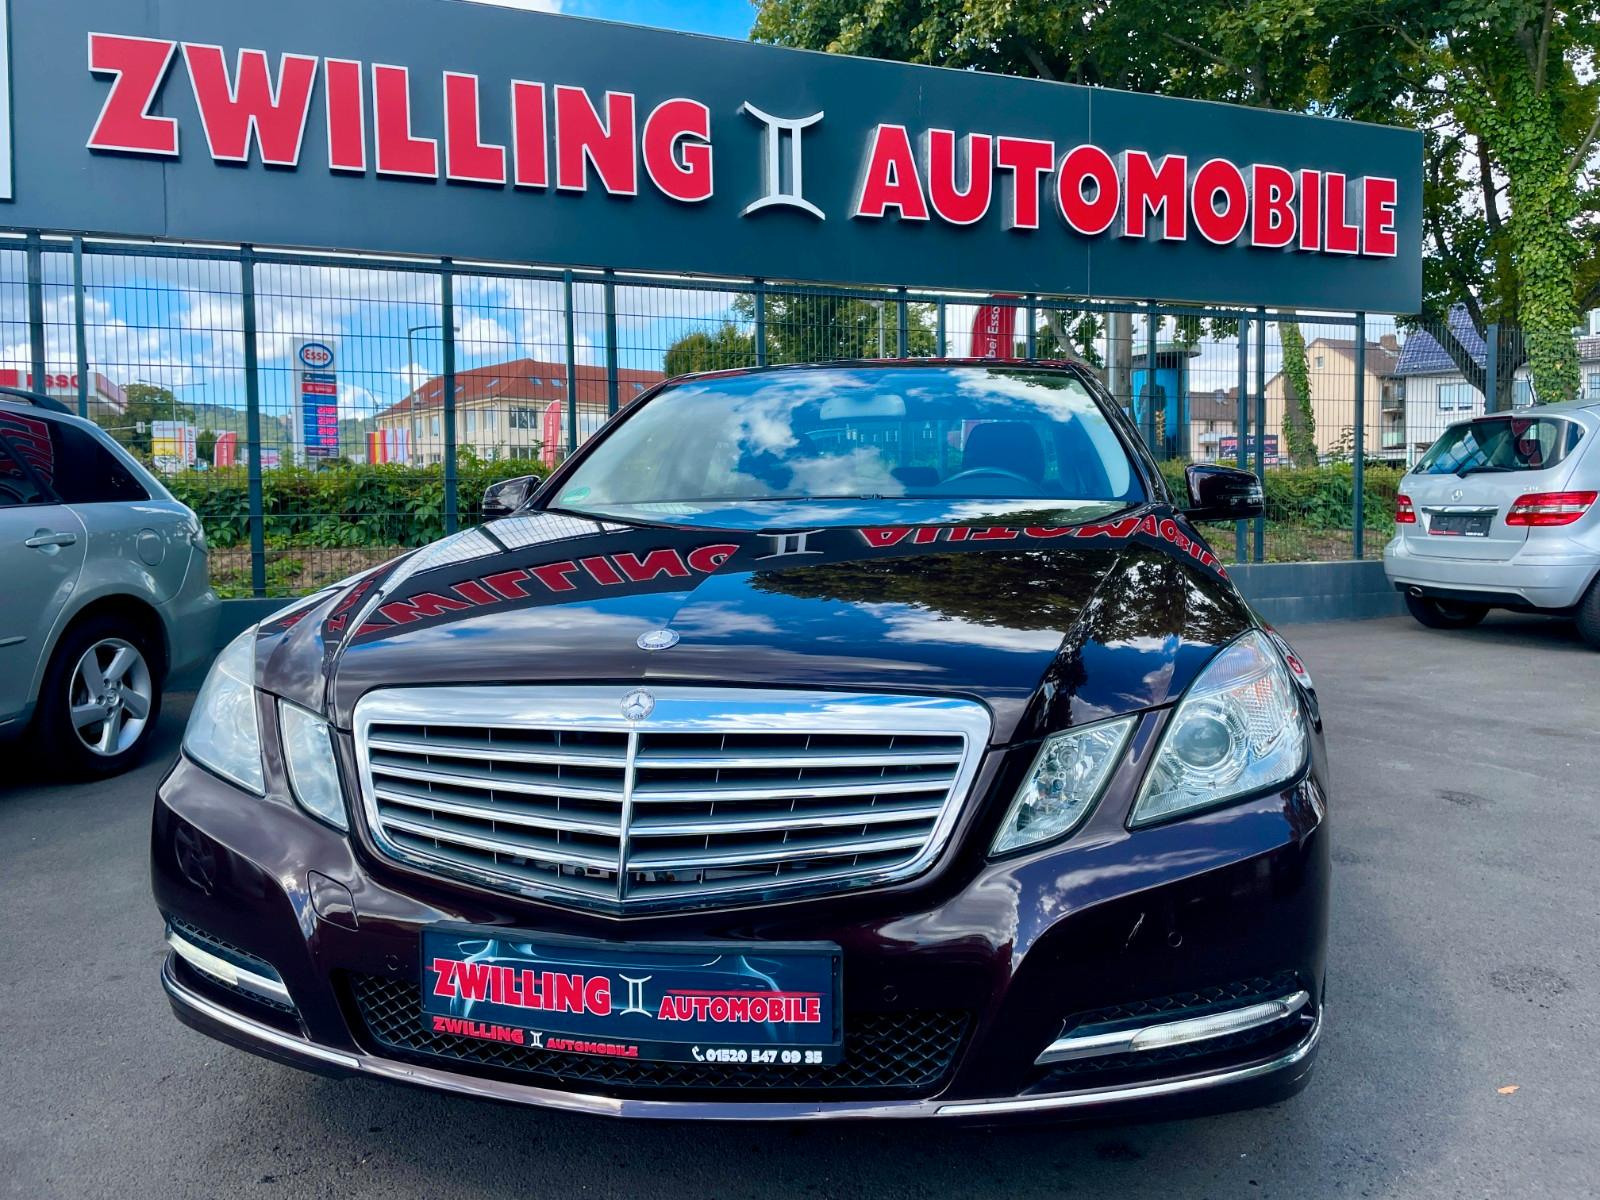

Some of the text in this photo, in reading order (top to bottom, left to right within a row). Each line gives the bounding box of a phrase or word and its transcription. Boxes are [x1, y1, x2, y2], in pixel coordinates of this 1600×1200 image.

[87, 31, 1399, 258] ZWILLING AUTOMOBILE
[985, 306, 1000, 358] bei Esso
[433, 958, 821, 1023] ZWILLING AUTOMOBILE
[432, 1016, 638, 1057] ZWILLING AUTOMOBILE
[705, 1049, 822, 1064] 01520 547 09 35
